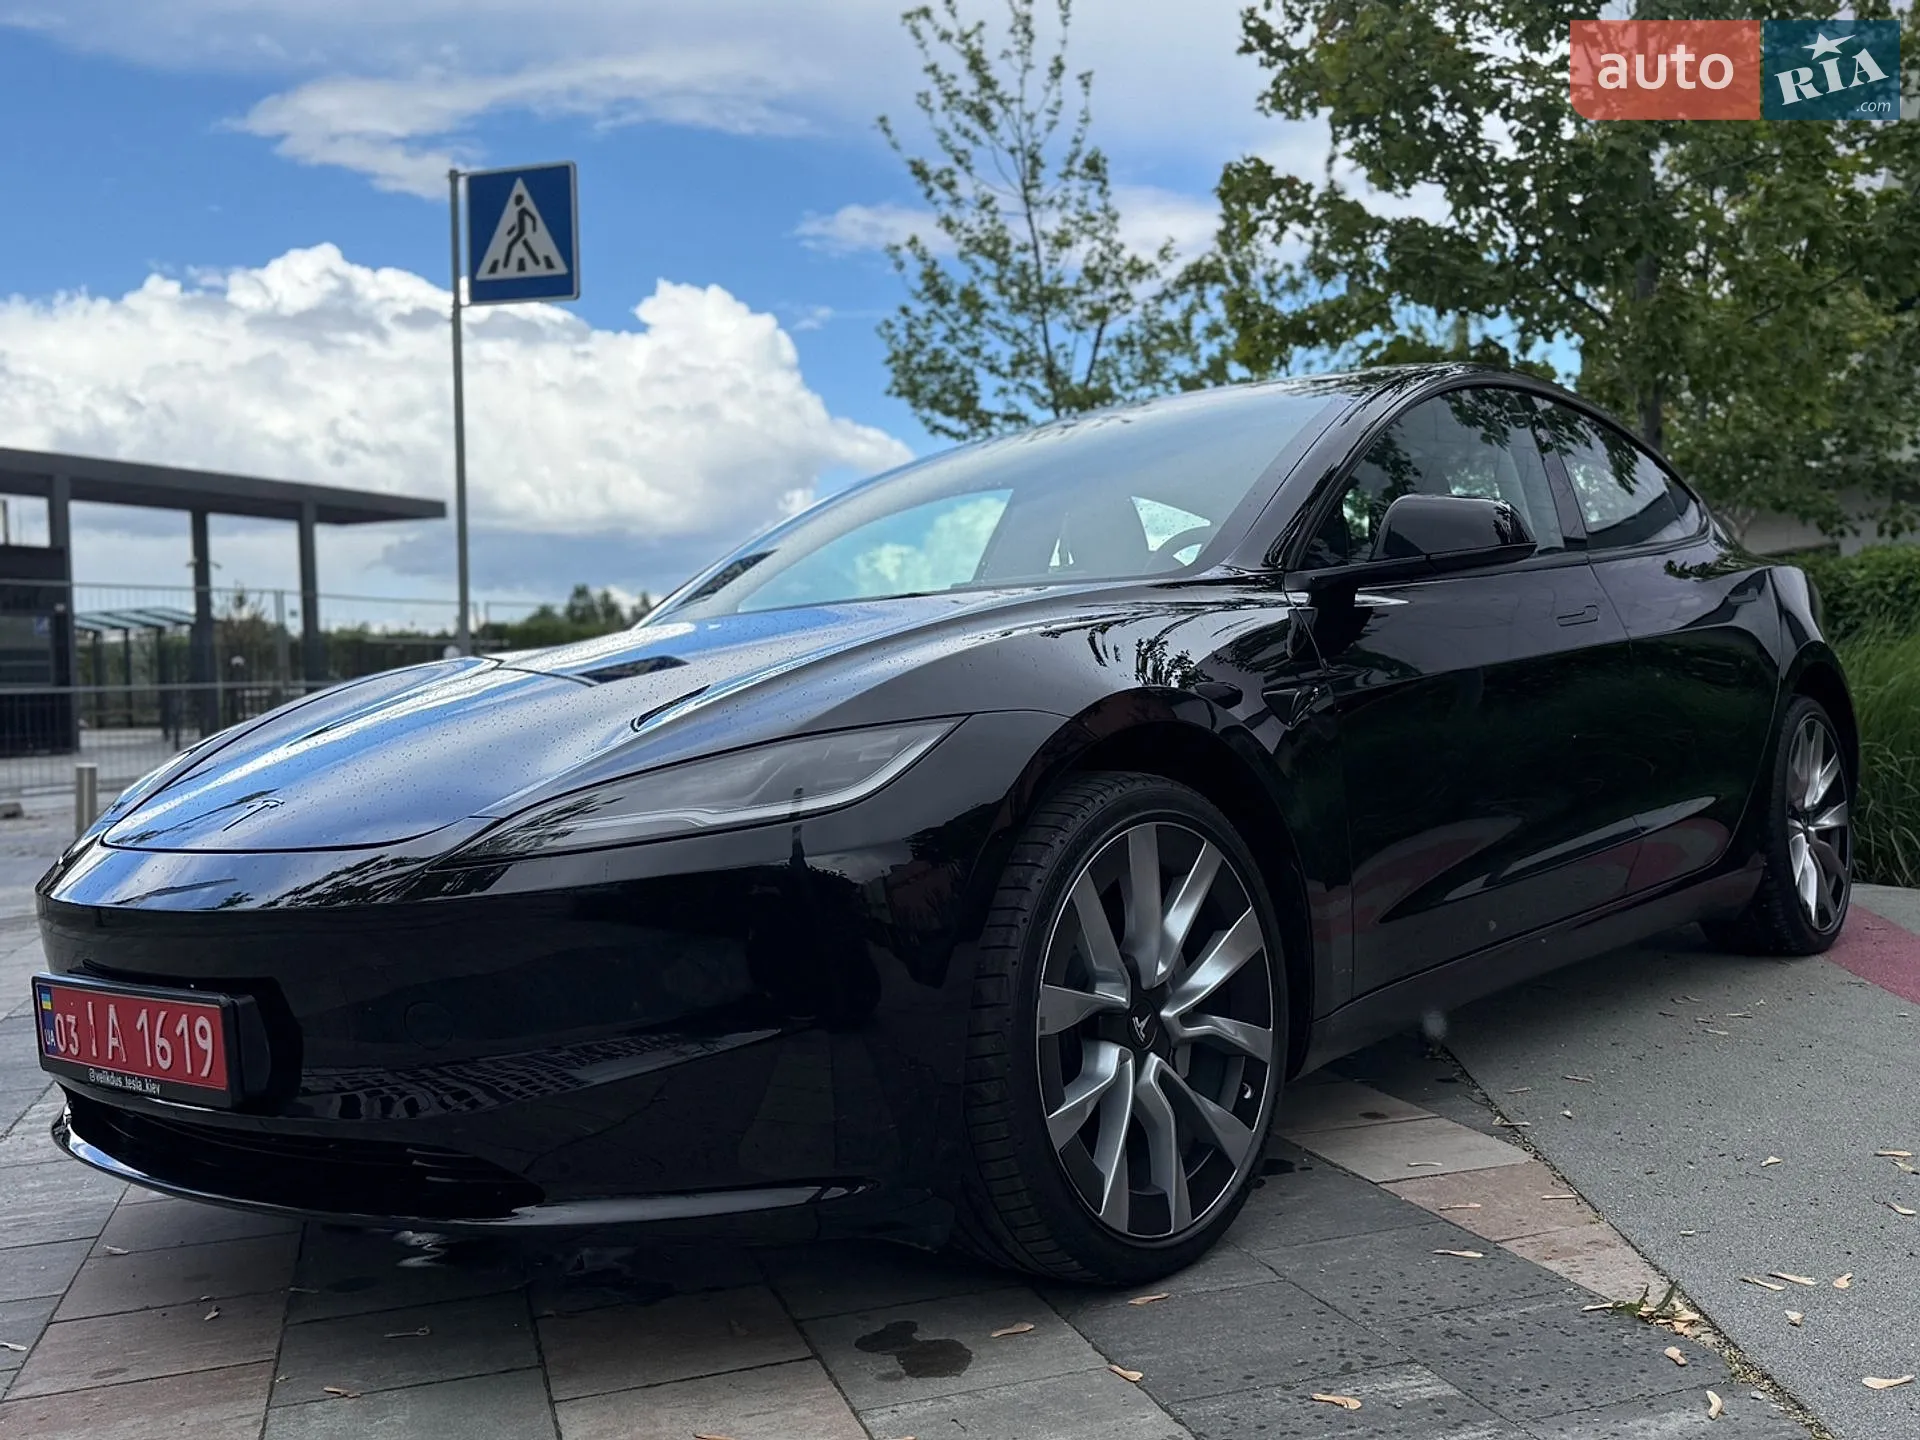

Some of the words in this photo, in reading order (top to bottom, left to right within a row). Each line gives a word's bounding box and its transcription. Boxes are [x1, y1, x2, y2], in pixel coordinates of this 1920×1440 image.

[44, 1029, 56, 1046] UA
[54, 1012, 79, 1056] 03
[136, 1008, 213, 1078] 1619
